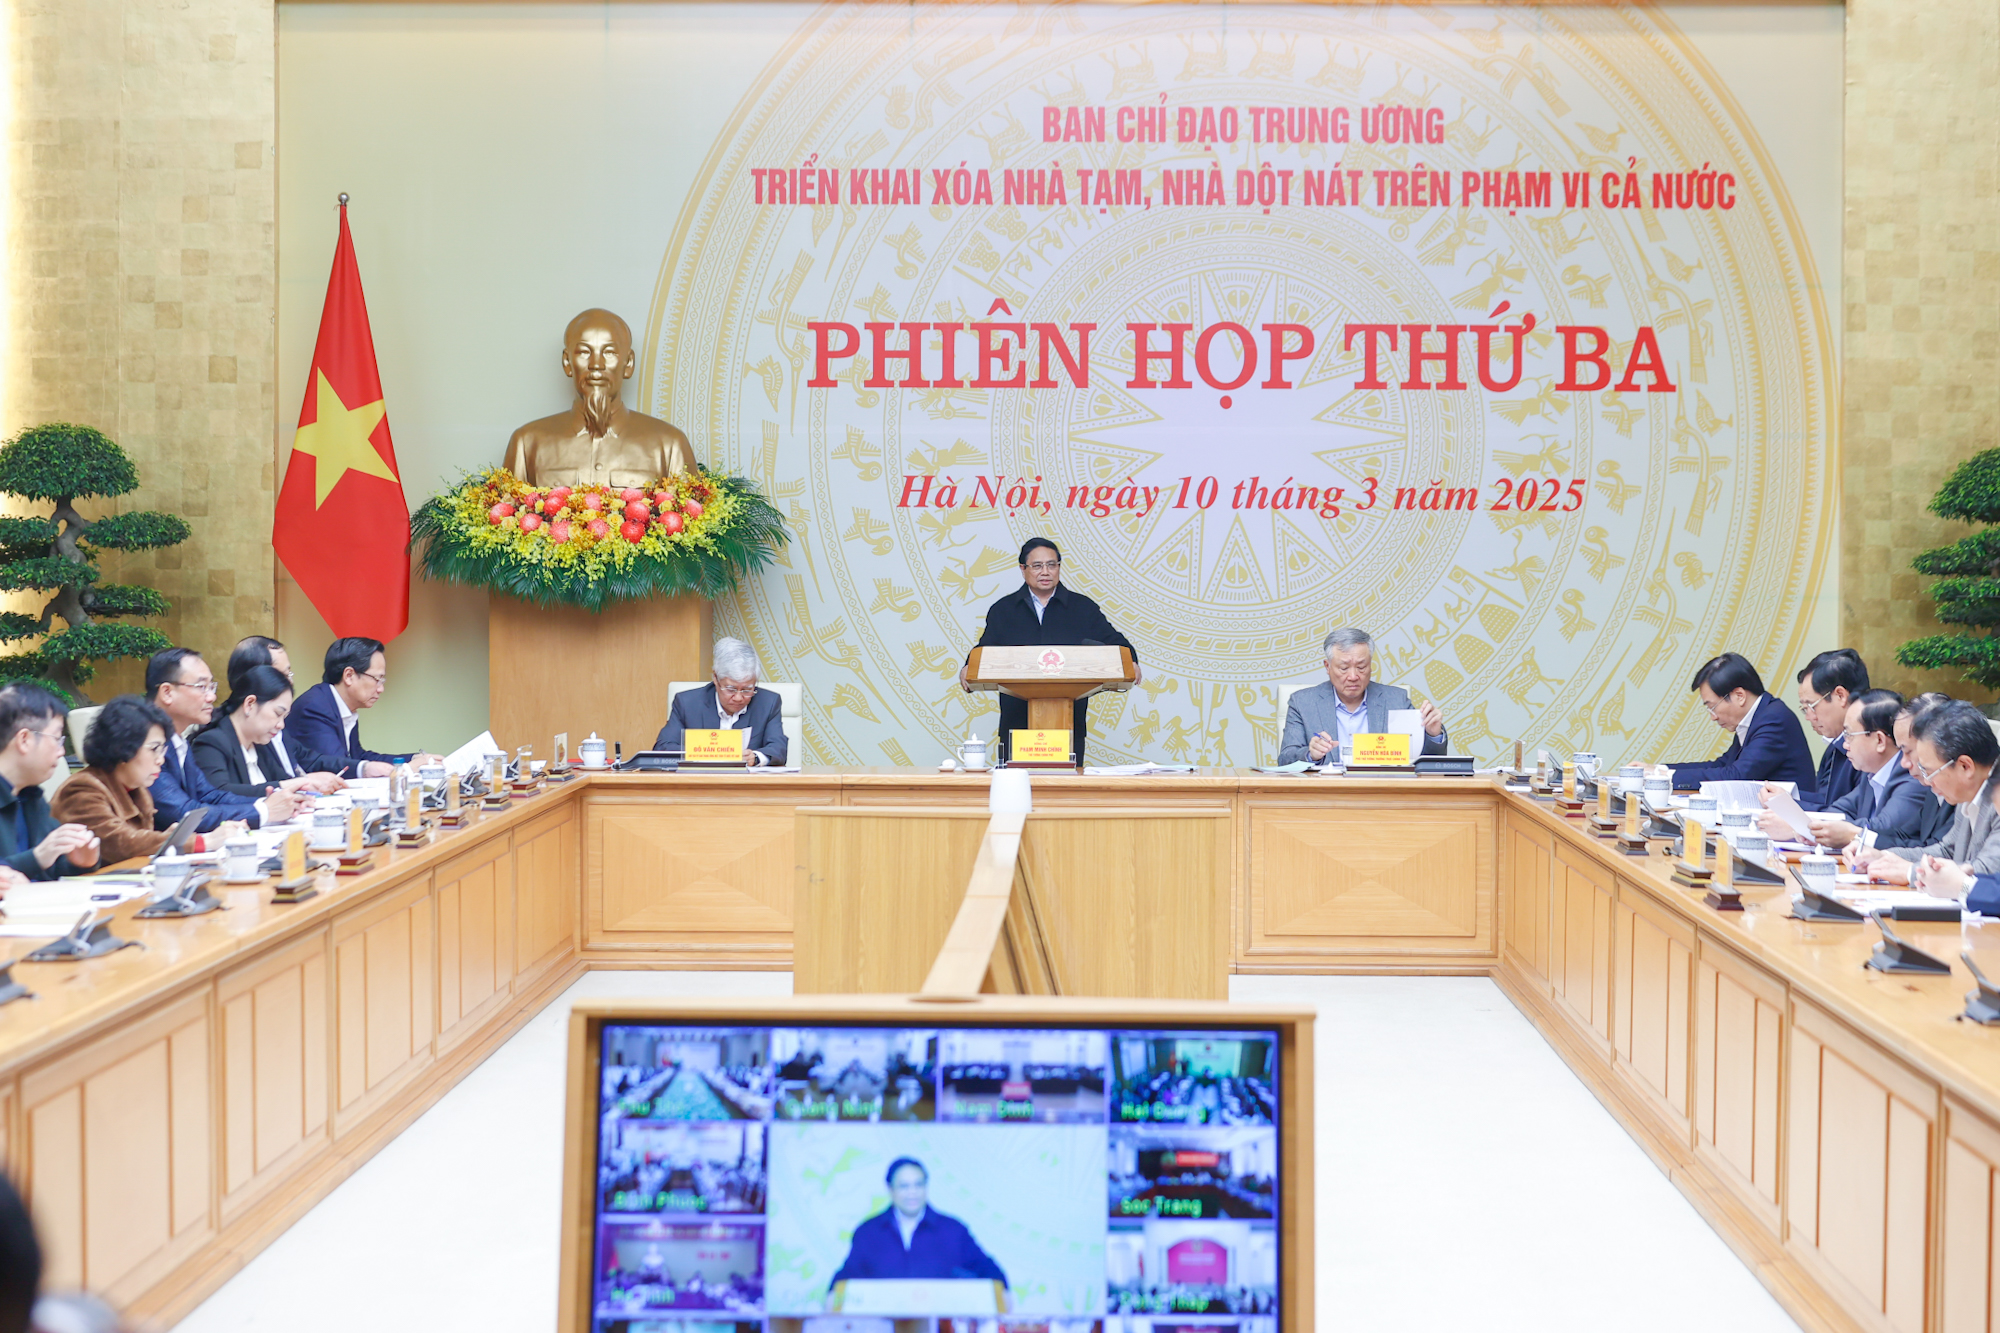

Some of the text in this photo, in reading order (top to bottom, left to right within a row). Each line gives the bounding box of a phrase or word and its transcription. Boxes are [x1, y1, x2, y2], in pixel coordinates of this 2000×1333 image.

[1044, 93, 1444, 150] BAN CHỈ ĐẠO TRUNG ƯƠNG
[752, 154, 1735, 216] TRIỂN KHAI XÓA NHÀ TẠM, NHÀ DỘT NÁT TRÊN PHẠM VI CẢ NƯỚC
[808, 298, 1676, 409] PHIÊN HỌP THỨ BA
[897, 476, 1585, 519] Hà Nội, ngày 10 tháng 3 năm 2025
